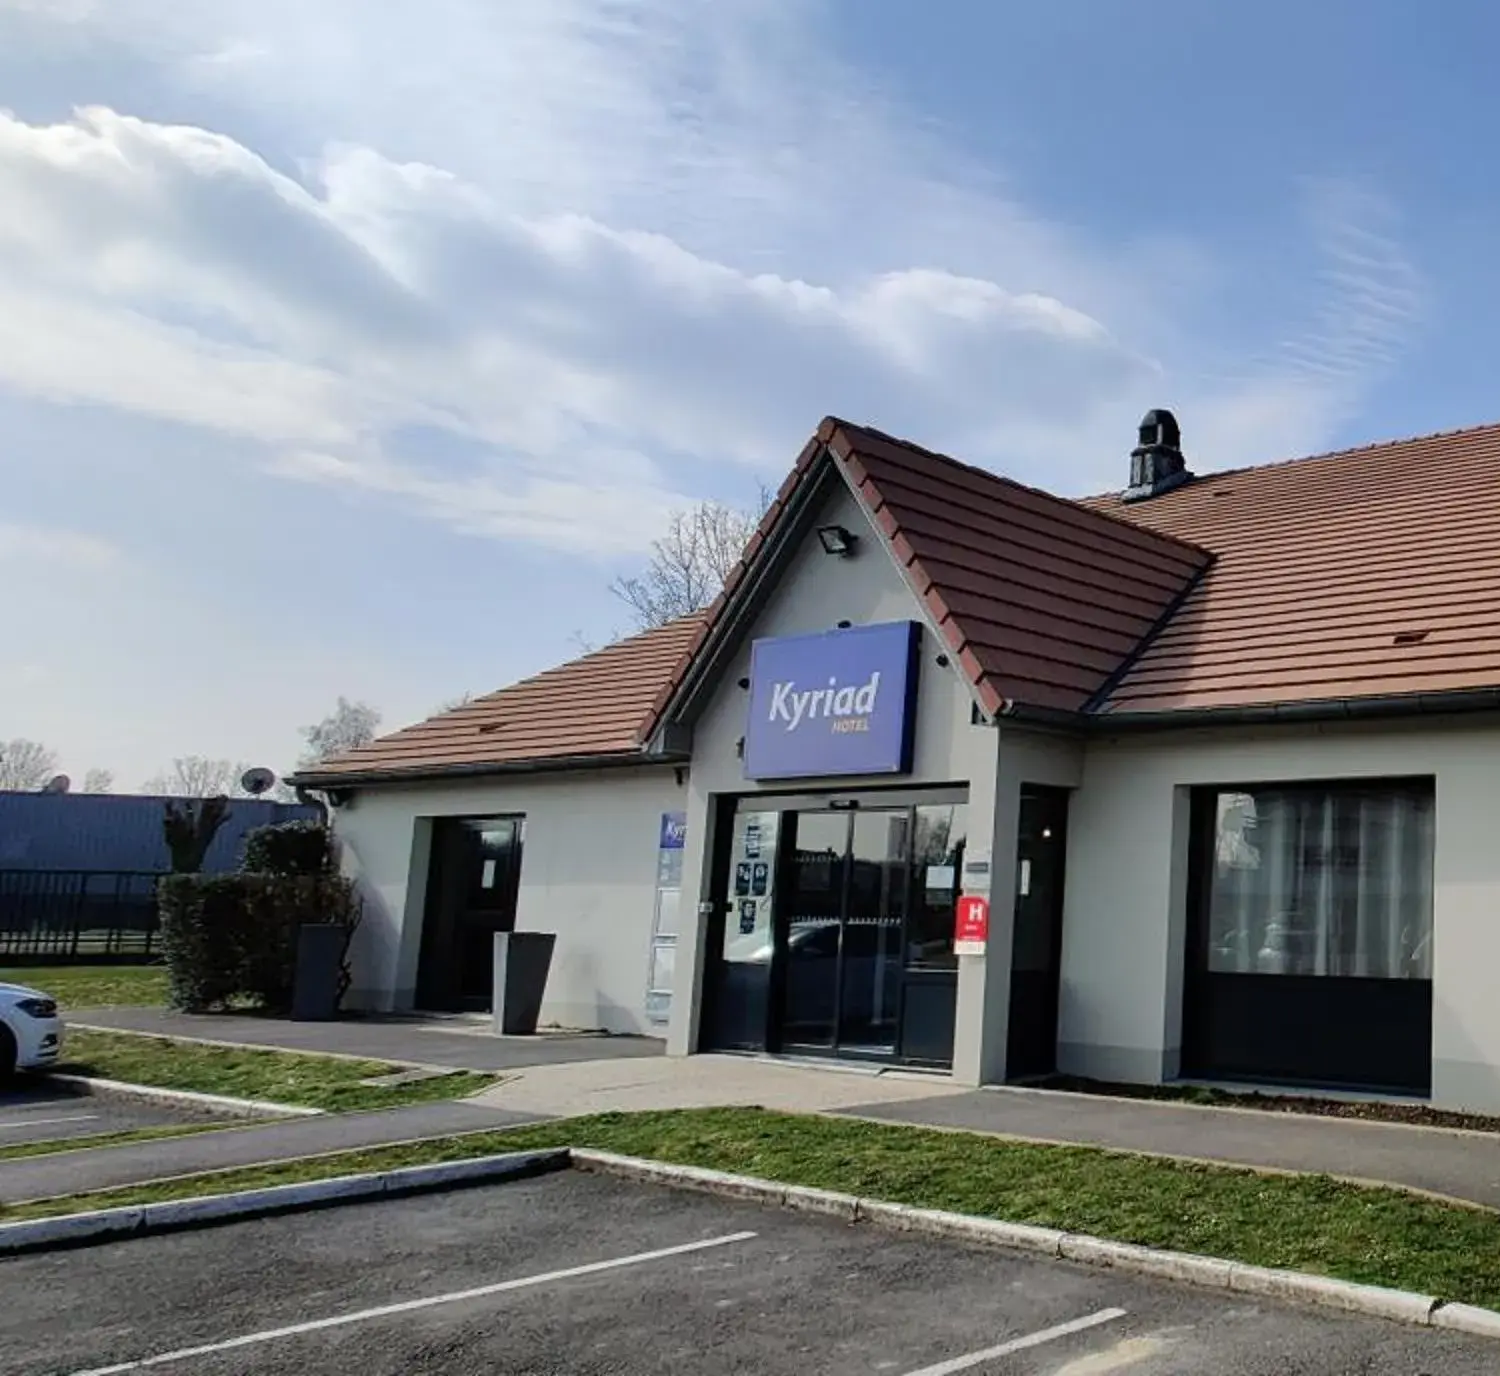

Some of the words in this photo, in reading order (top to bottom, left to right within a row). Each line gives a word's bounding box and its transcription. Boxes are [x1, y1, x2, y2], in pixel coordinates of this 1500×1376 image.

[768, 671, 881, 731] Kyriad
[831, 717, 869, 734] HOTEL
[968, 903, 984, 922] H
